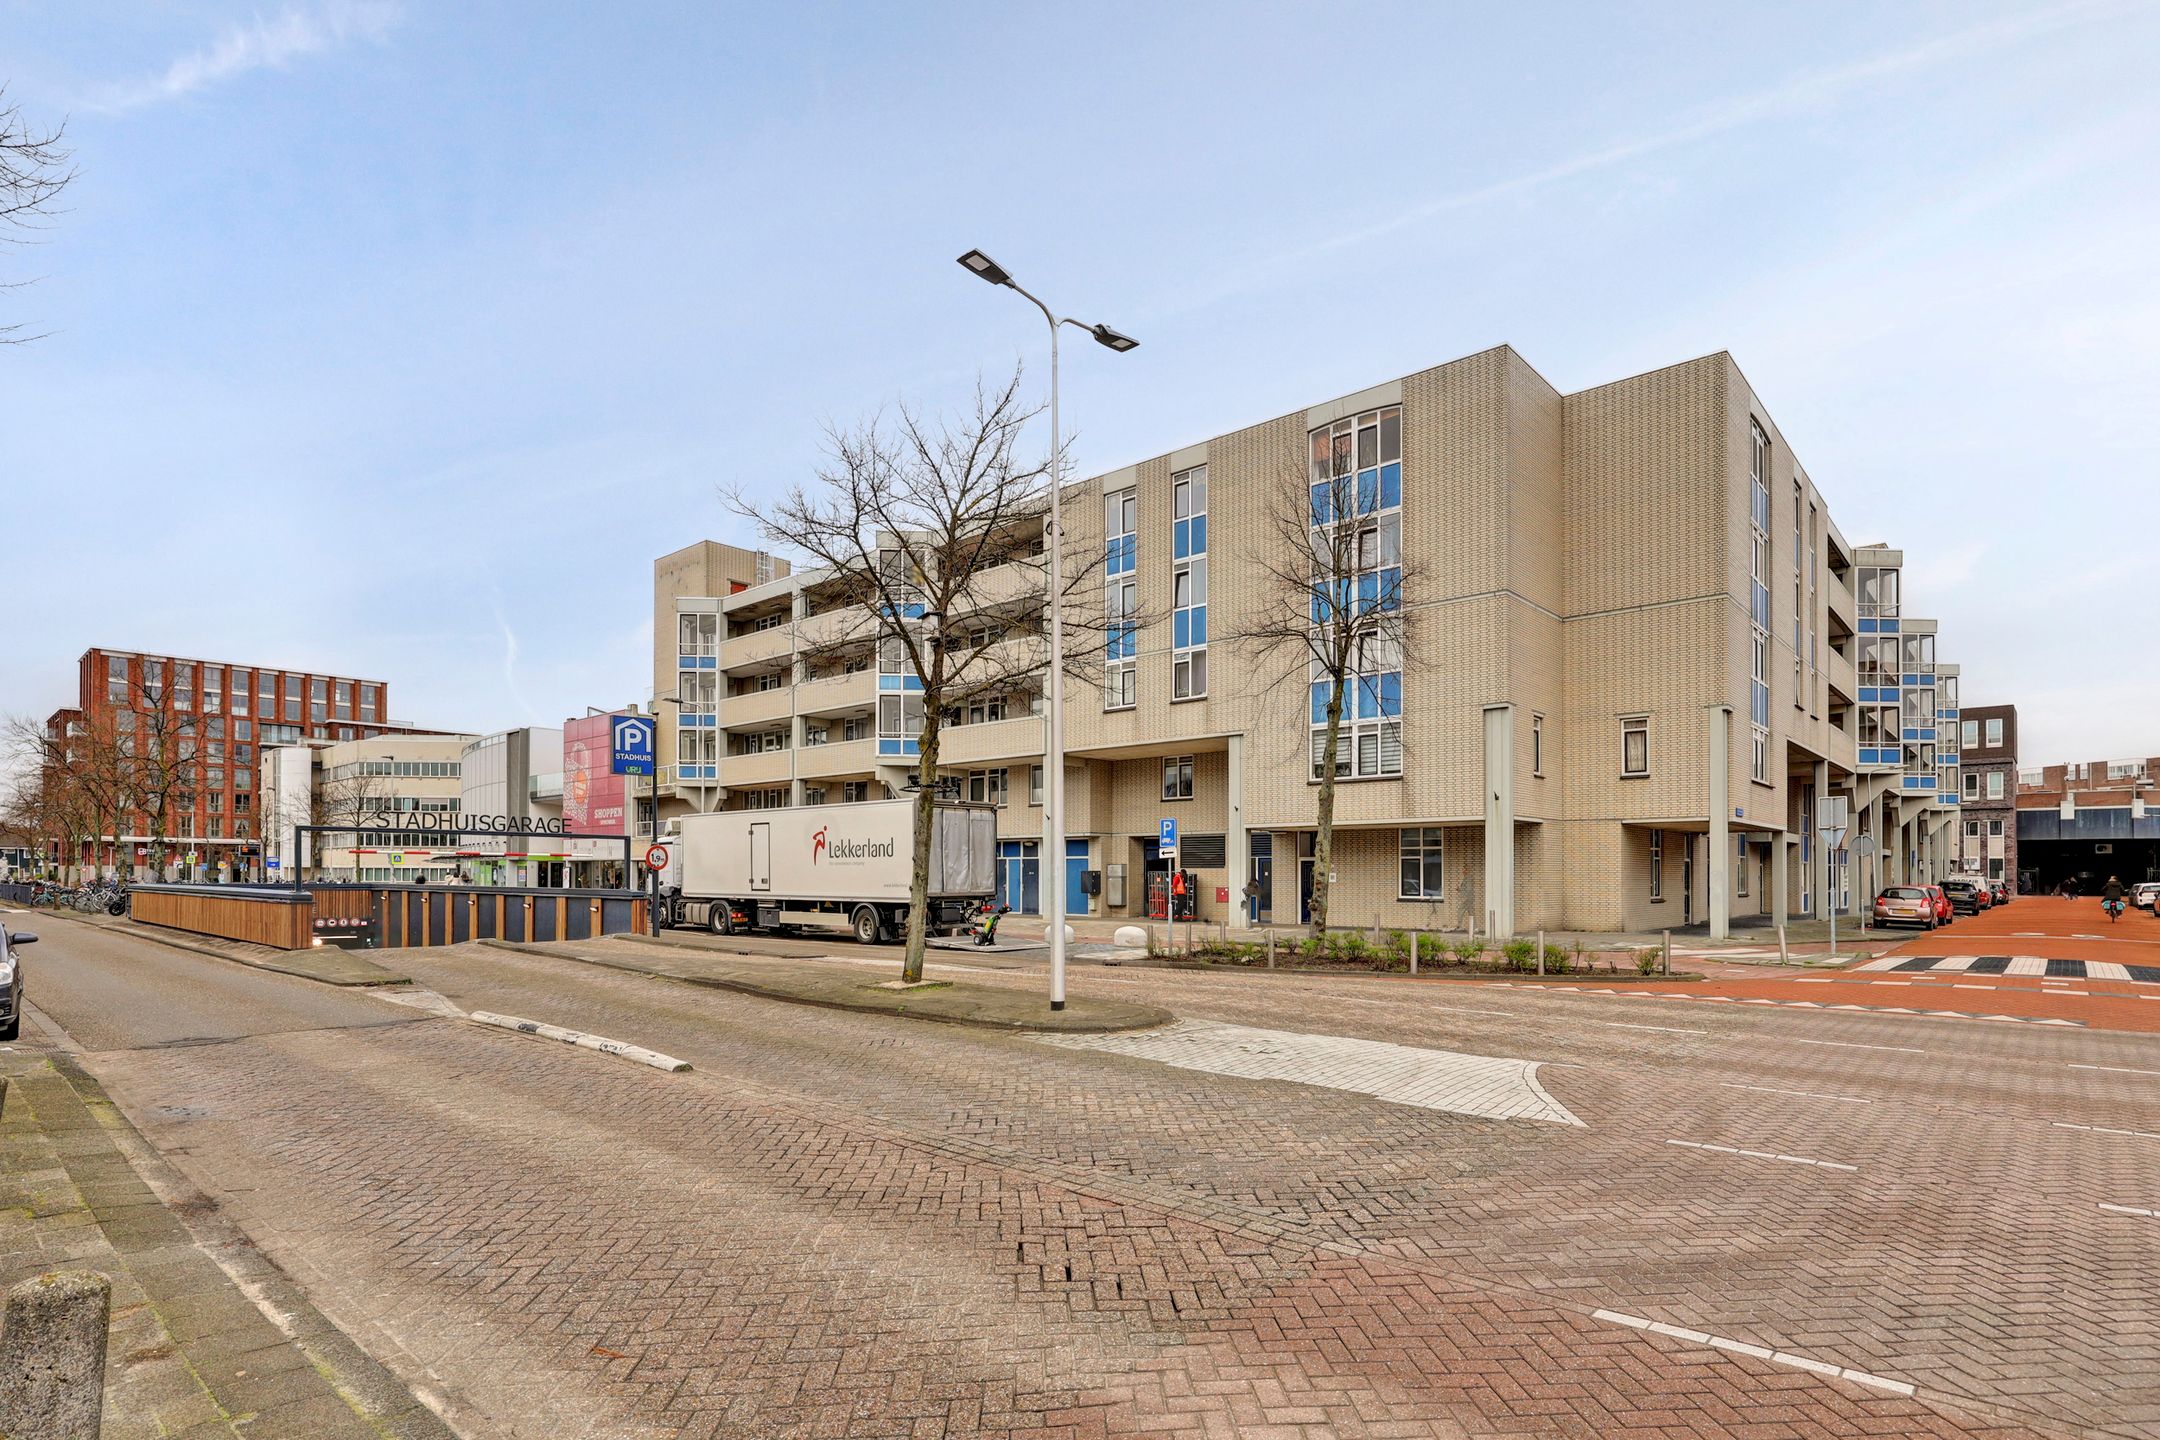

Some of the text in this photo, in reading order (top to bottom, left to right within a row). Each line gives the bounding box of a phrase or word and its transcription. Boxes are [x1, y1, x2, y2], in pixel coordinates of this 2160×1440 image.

[624, 728, 643, 751] P
[615, 752, 652, 762] STADHUIS
[594, 807, 623, 819] SHOPPEN
[376, 811, 573, 834] STADHUISGARAGE
[1163, 821, 1172, 836] P
[828, 837, 894, 858] Lekkerland
